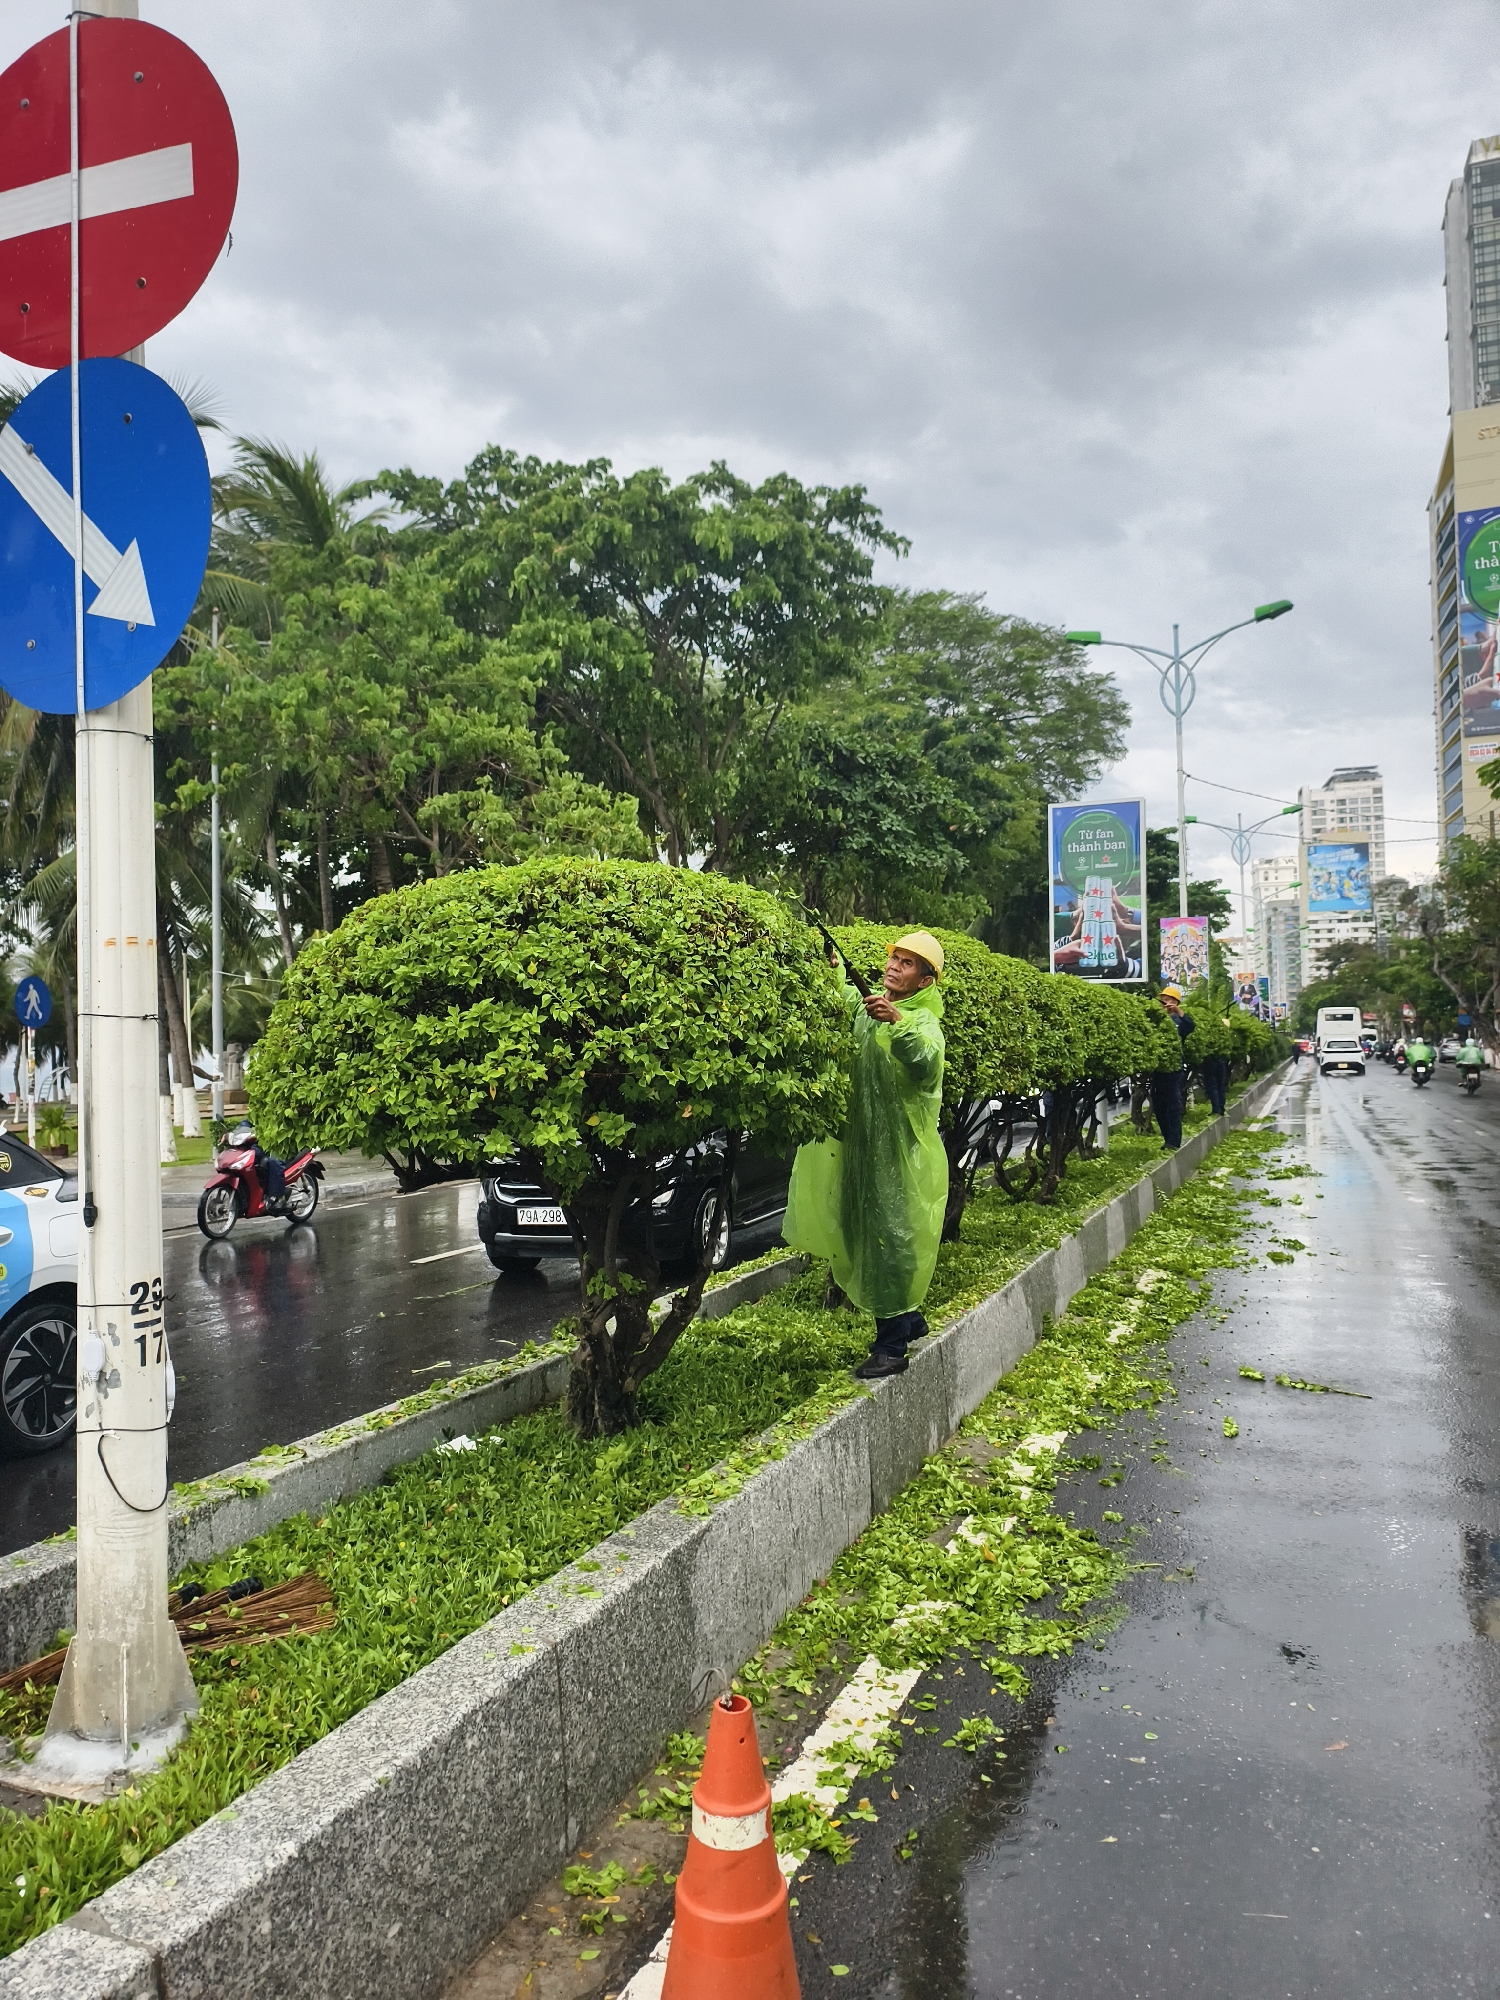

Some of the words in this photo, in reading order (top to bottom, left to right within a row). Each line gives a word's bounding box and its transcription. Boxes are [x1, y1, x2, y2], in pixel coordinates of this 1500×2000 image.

[1078, 828, 1094, 840] Từ
[1095, 828, 1114, 839] fan
[1067, 840, 1102, 853] thành
[1103, 839, 1126, 853] bạn
[133, 1329, 164, 1368] 17
